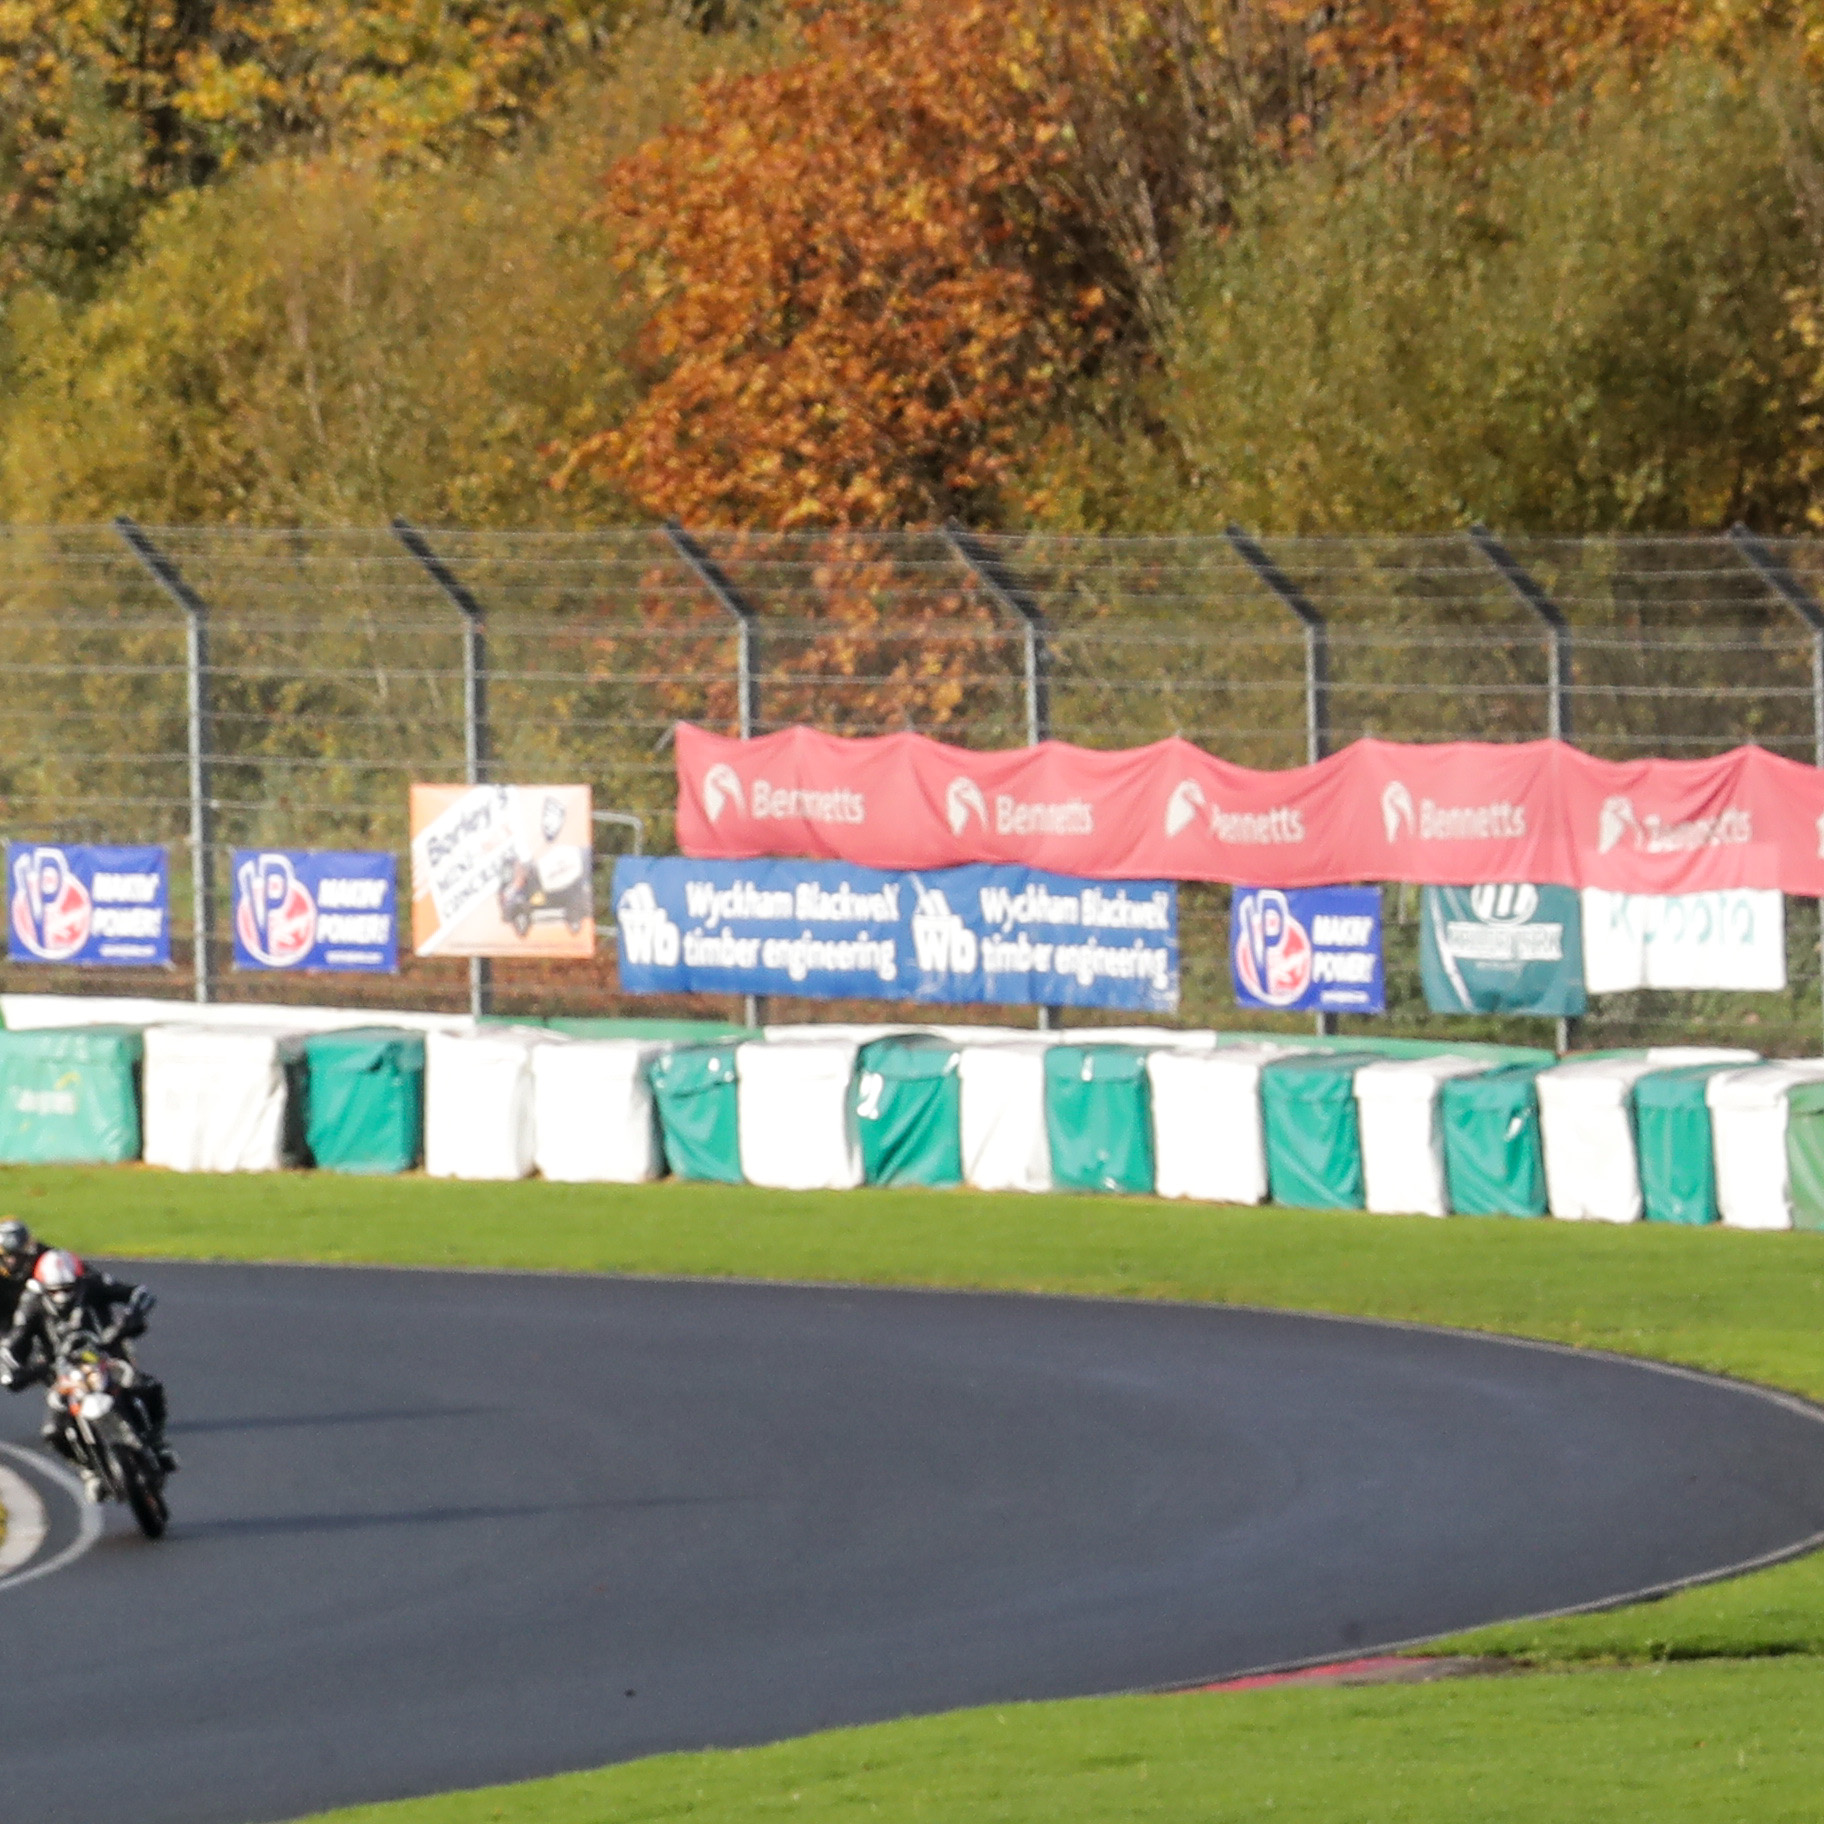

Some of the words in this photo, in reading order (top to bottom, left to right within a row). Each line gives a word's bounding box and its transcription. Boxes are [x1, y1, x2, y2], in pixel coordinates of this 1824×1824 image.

[753, 779, 864, 824] Bennetts
[996, 794, 1094, 836] Bennetts
[1419, 797, 1526, 840] Bennetts
[685, 880, 793, 929] Wyckham
[794, 881, 900, 921] Blackwell
[980, 883, 1079, 933] Wyckham
[1081, 887, 1169, 930] Blackwell
[684, 926, 760, 967] timber
[762, 929, 897, 981] engineering
[982, 931, 1052, 973] timber
[1055, 936, 1169, 990] engineering
